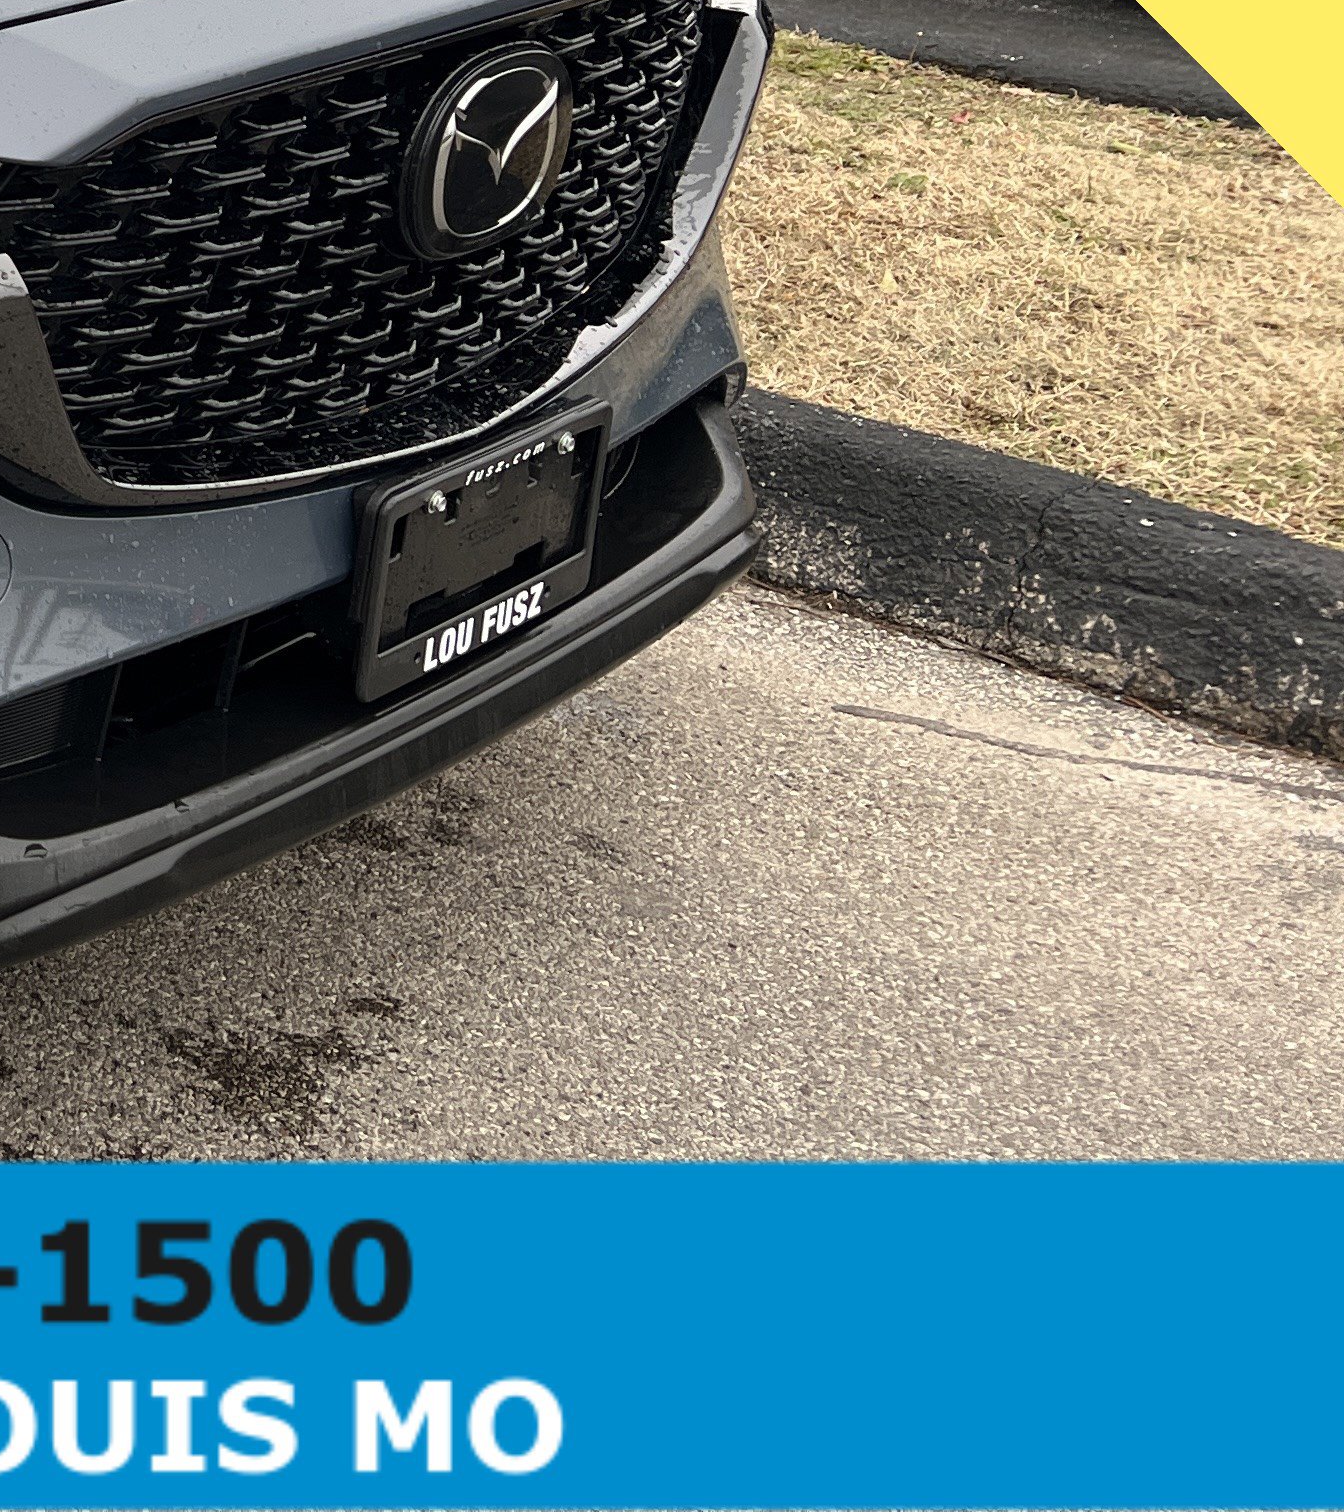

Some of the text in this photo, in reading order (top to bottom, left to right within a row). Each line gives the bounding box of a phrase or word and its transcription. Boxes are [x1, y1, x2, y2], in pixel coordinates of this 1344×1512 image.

[465, 441, 545, 486] fusz.com
[423, 581, 545, 672] LOU FUSZ
